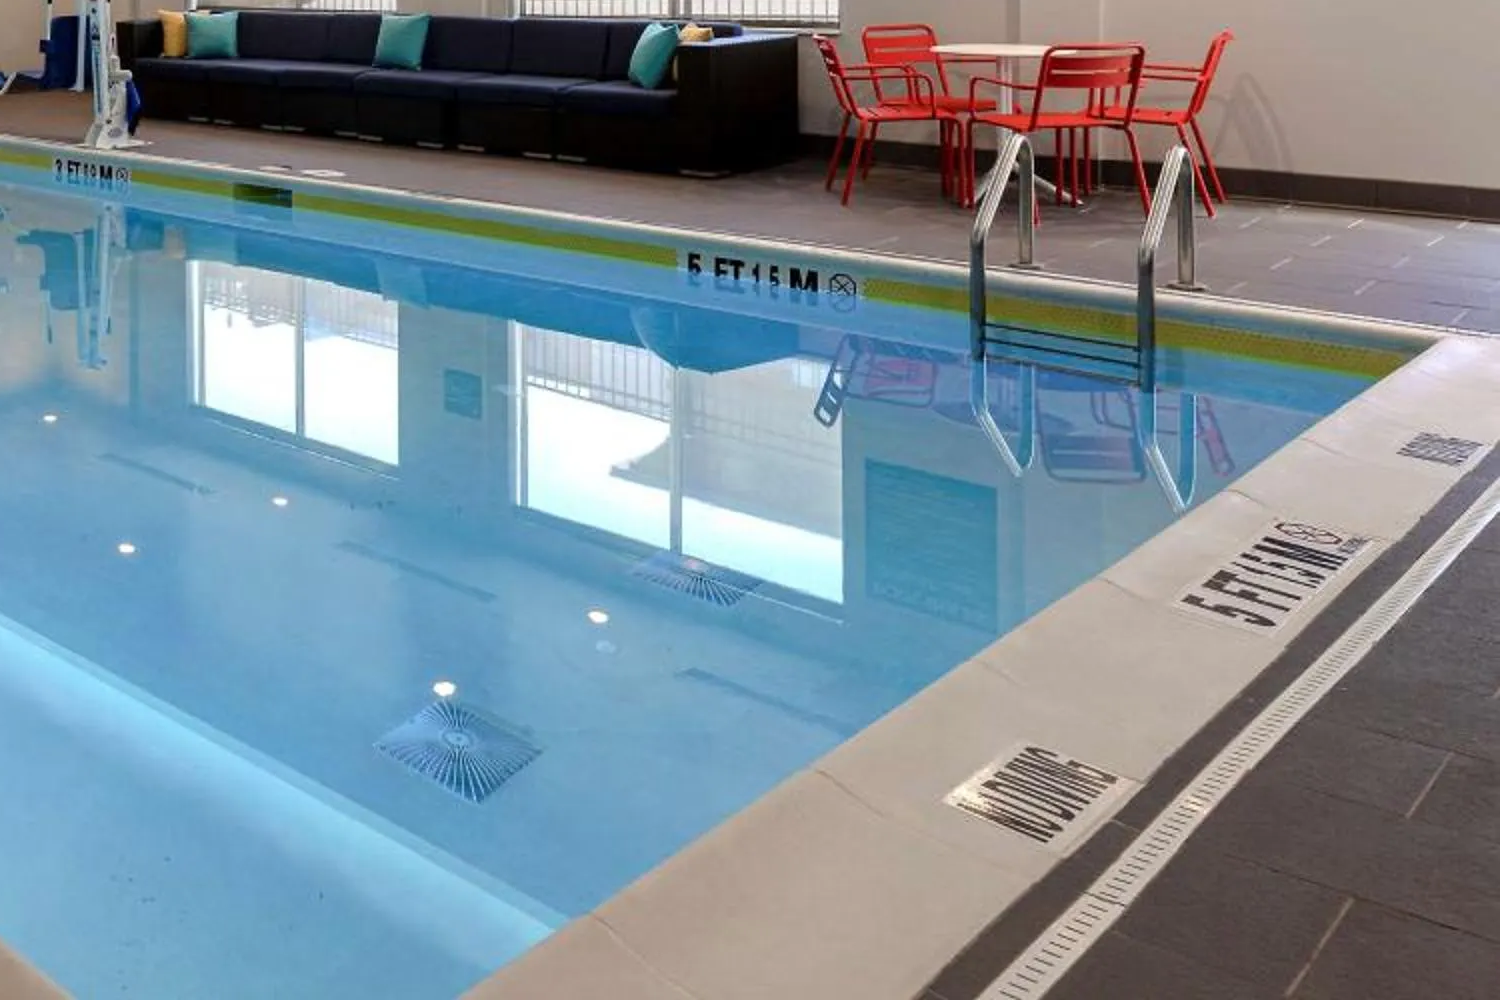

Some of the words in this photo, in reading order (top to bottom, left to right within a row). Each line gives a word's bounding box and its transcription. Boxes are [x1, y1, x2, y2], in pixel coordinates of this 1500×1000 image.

[714, 256, 745, 281] FT
[789, 267, 819, 293] M
[1253, 536, 1349, 571] M
[1181, 593, 1277, 627] 5
[1201, 569, 1303, 613] FT
[981, 746, 1119, 822] DIVING
[956, 792, 1064, 844] NO
